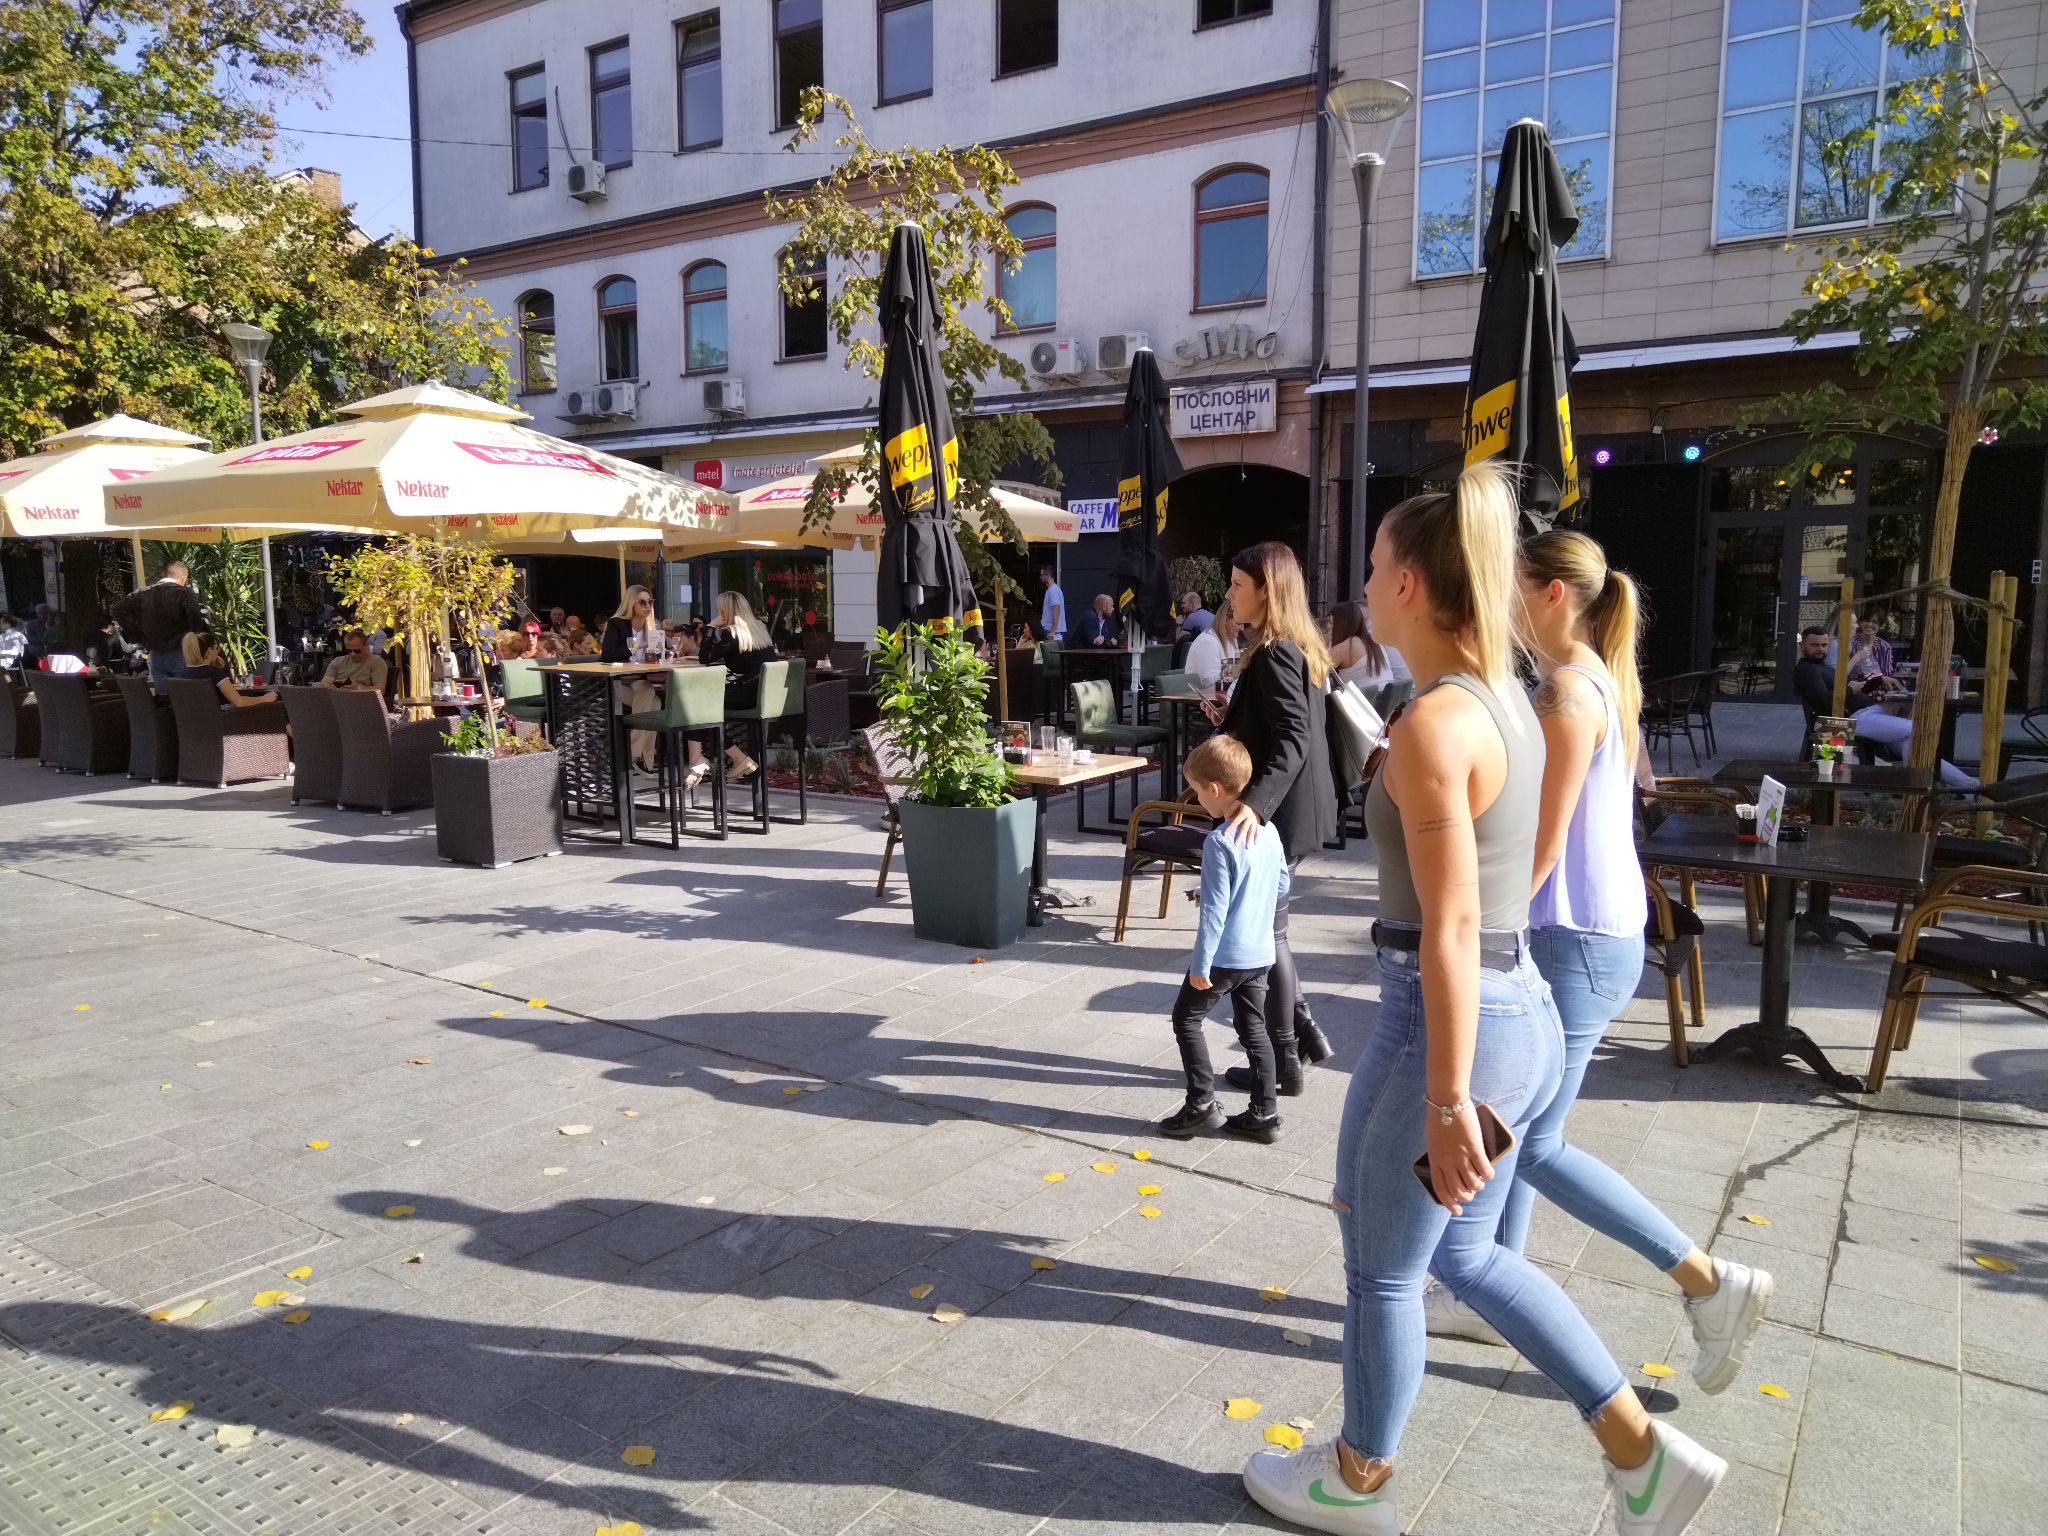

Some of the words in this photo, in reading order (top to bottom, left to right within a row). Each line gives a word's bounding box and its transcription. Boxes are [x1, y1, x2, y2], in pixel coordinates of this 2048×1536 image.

[1176, 388, 1270, 410] ПОСЛОВНИ
[1190, 410, 1256, 431] ЦЕНТАР
[732, 464, 757, 478] imate
[326, 478, 364, 496] Nektar
[397, 479, 450, 498] Nektar
[112, 494, 142, 509] Nektar
[695, 501, 730, 516] Nektar
[22, 506, 80, 520] Nektar
[856, 513, 885, 525] Nekta
[1070, 503, 1103, 514] CAFFE
[1101, 502, 1119, 528] M
[1053, 520, 1073, 532] Nektar
